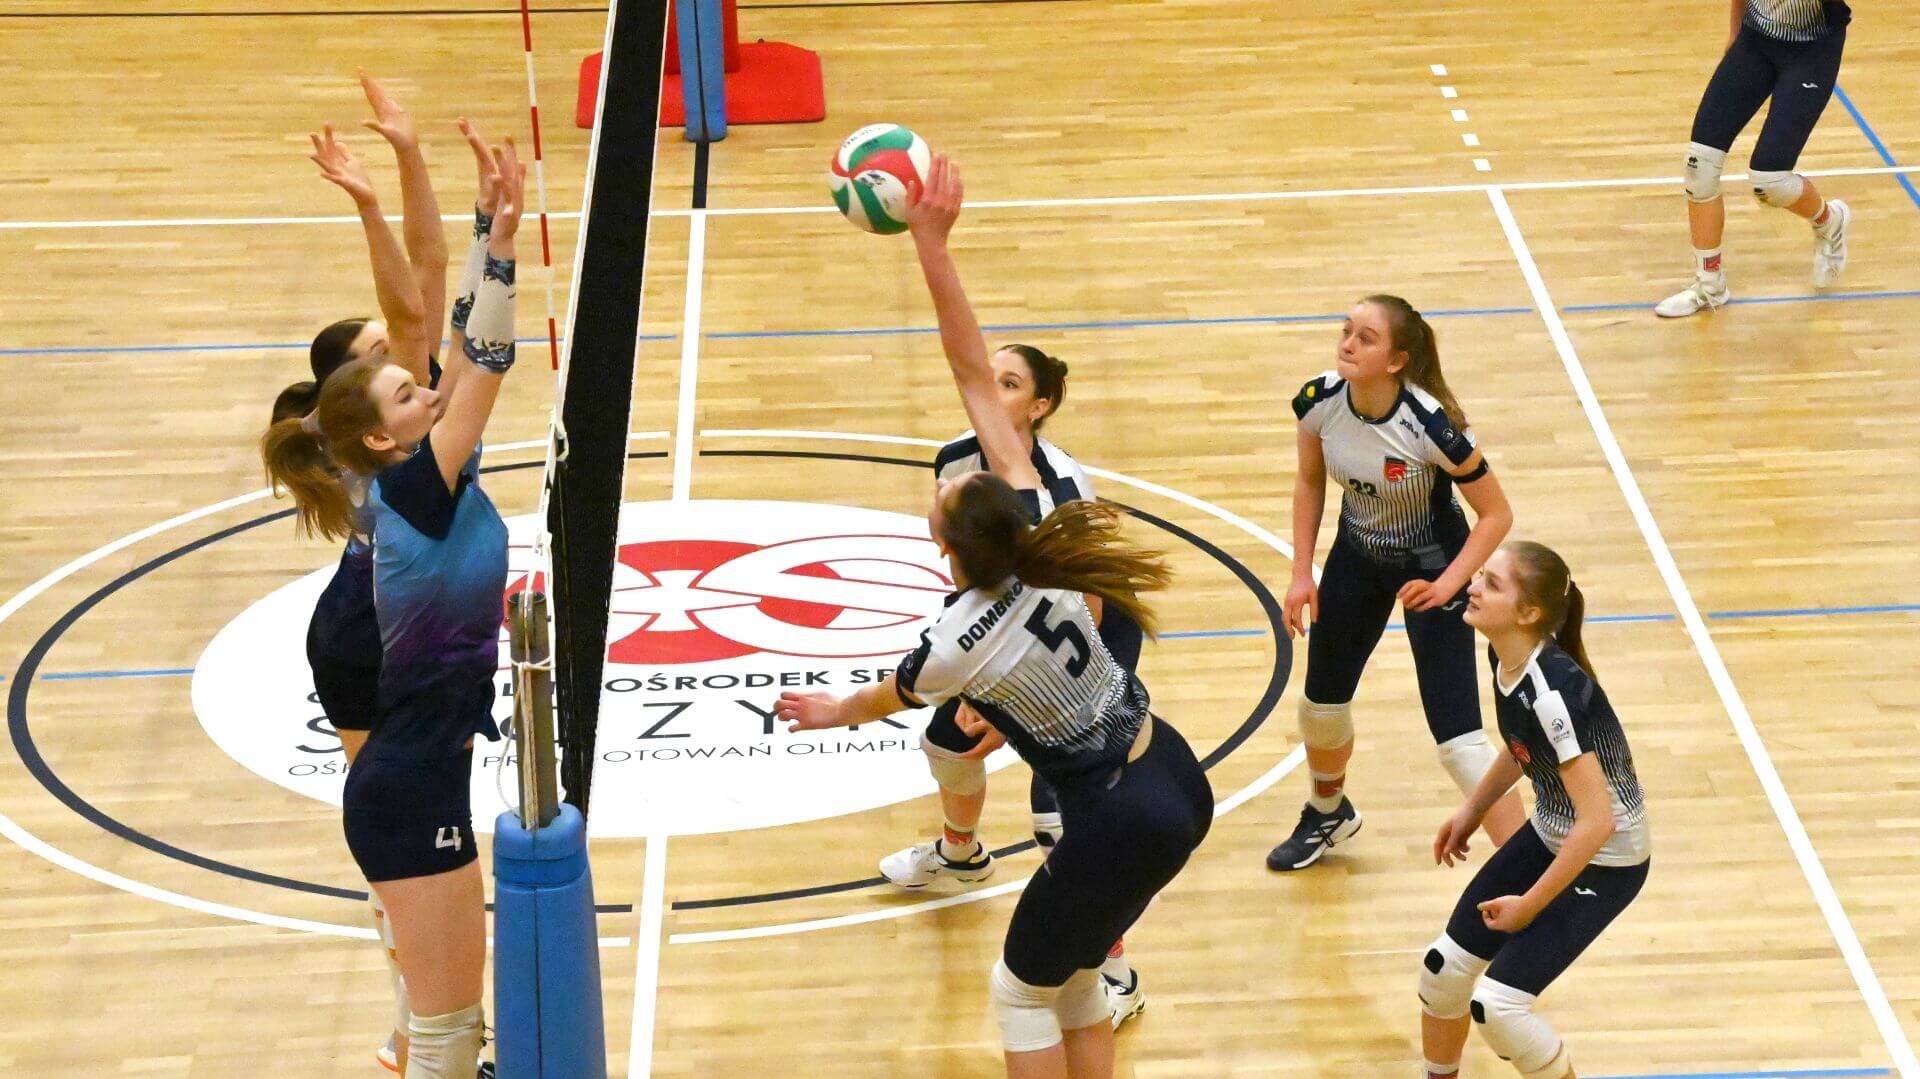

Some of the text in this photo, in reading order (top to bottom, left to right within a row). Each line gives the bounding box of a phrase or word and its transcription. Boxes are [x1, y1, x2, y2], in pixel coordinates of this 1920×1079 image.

[957, 580, 1024, 653] DOMBRO
[1024, 596, 1091, 679] 5
[604, 671, 832, 693] OŚRODEK
[435, 826, 463, 852] 4
